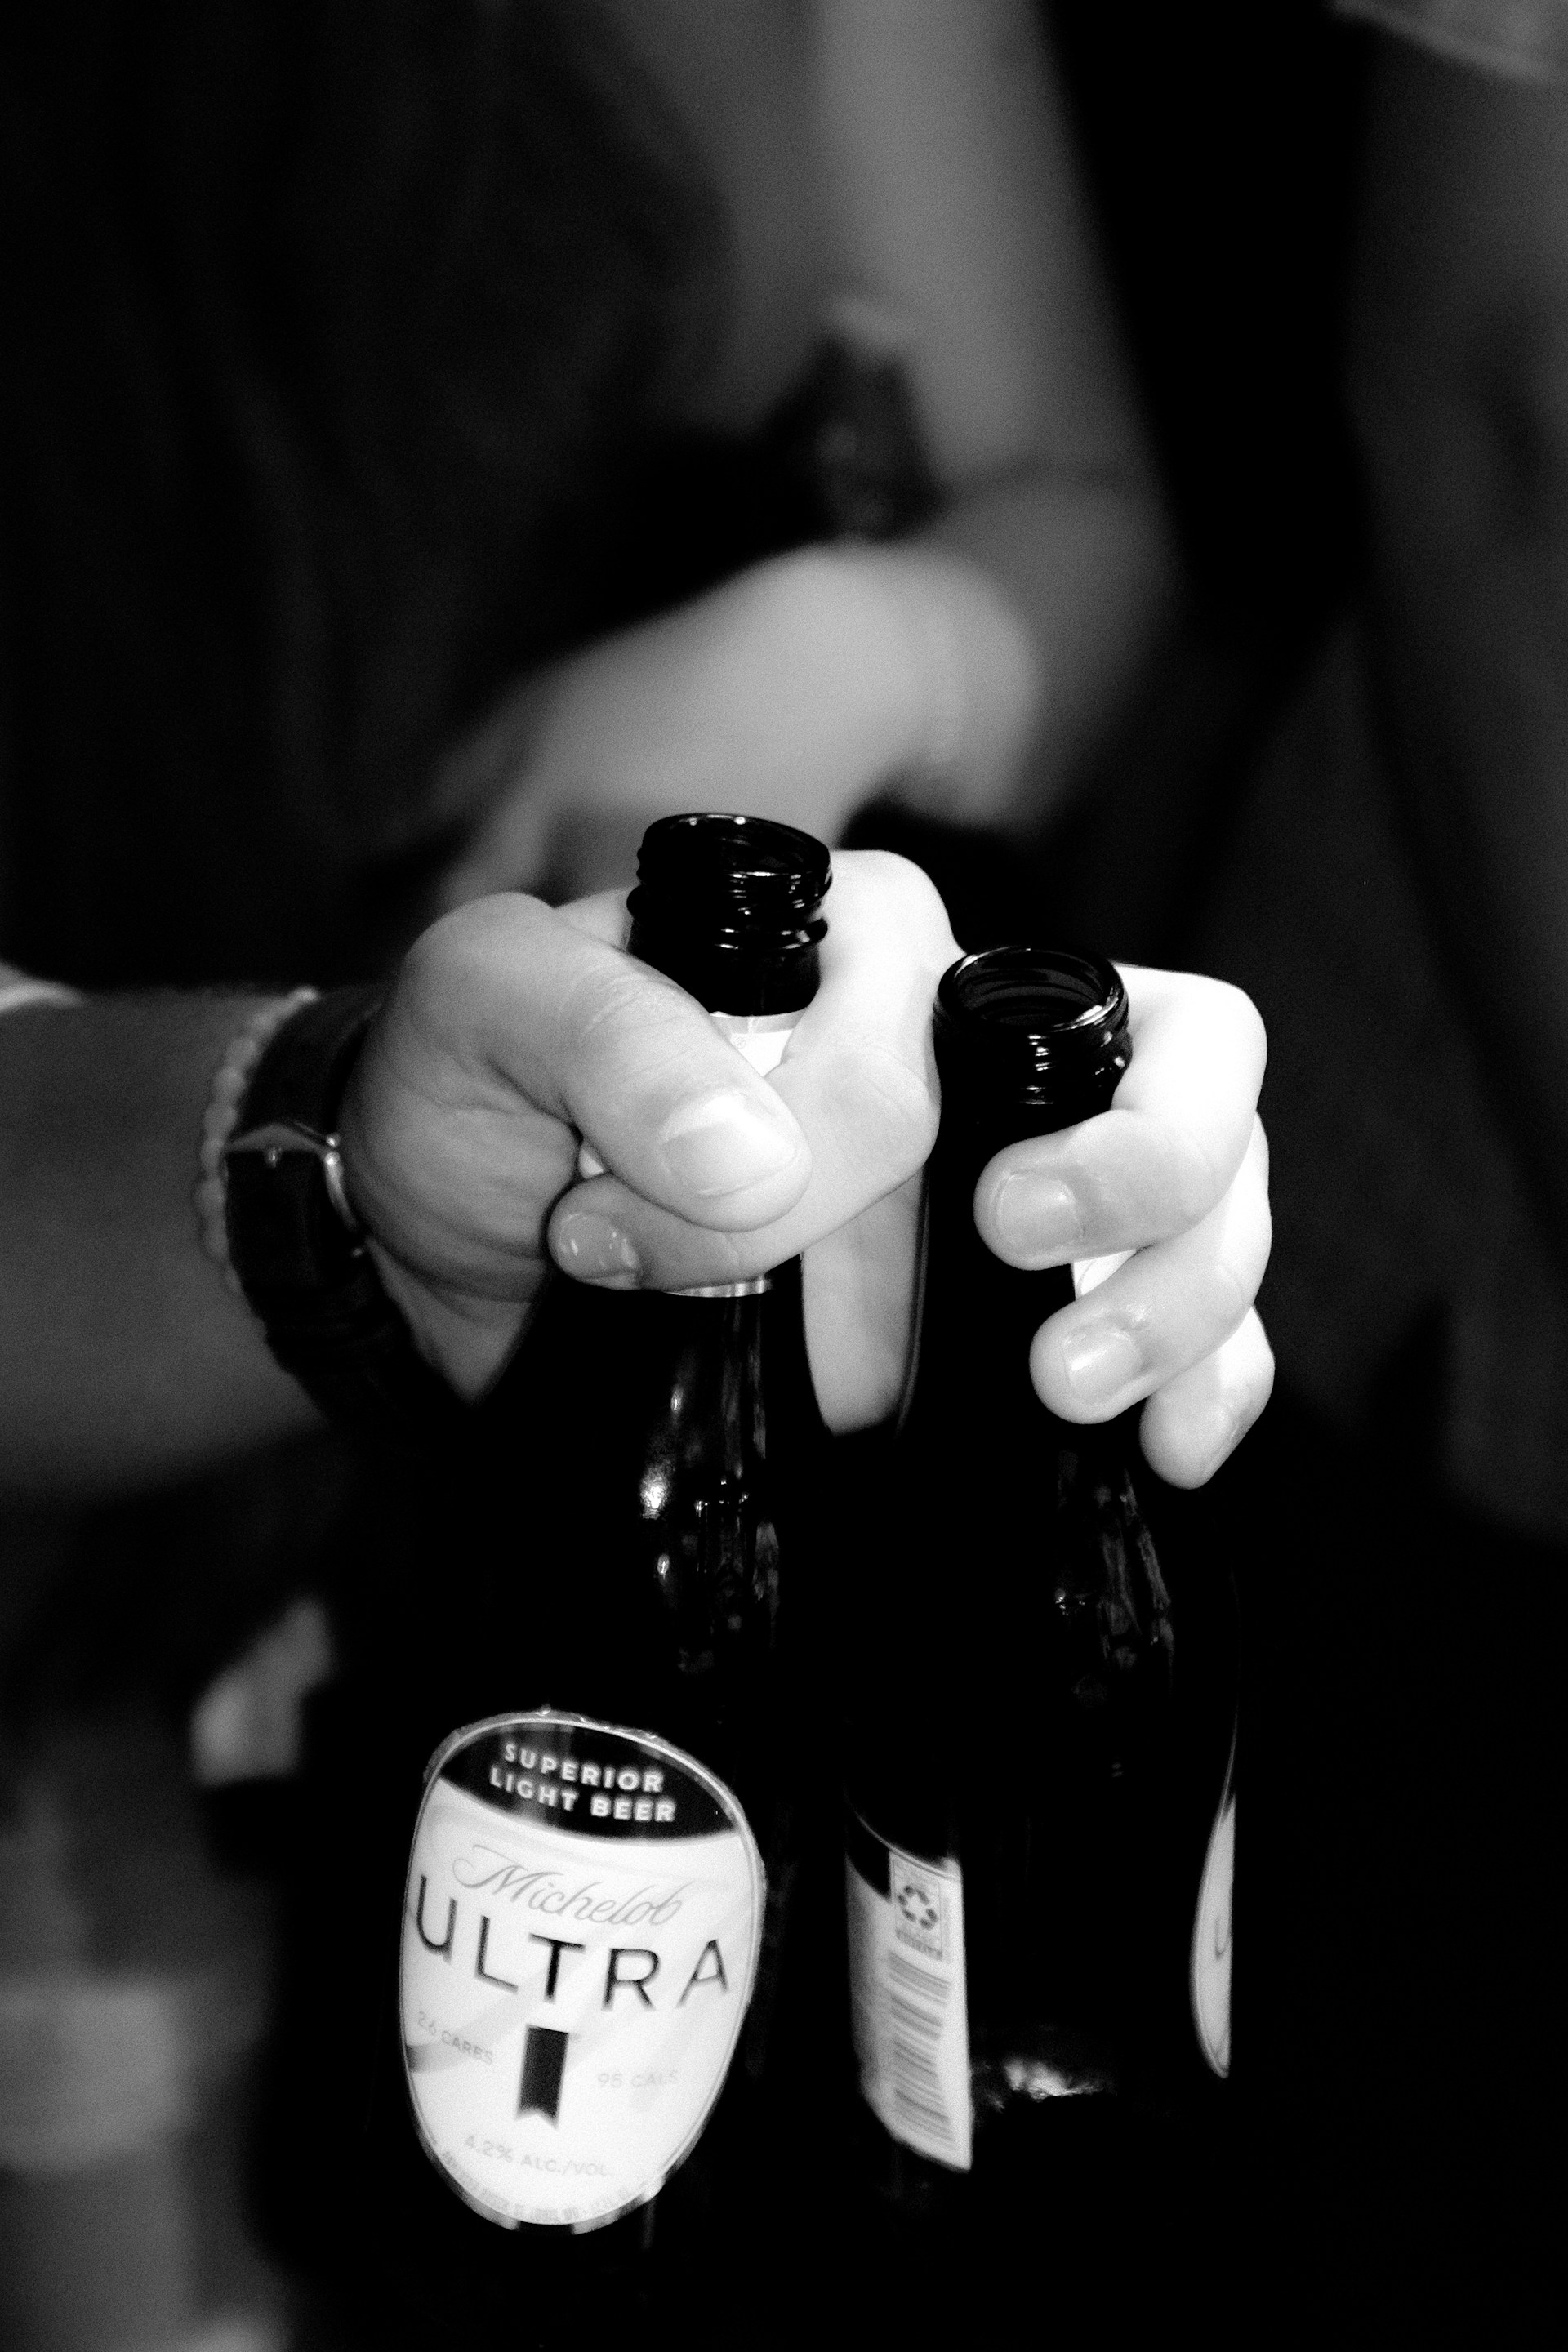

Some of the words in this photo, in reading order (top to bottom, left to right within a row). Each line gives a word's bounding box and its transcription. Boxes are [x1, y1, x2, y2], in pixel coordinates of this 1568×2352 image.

[505, 1743, 664, 1793] SUPERIOR
[490, 1767, 579, 1811] LIGHT
[590, 1796, 677, 1822] BEER
[452, 1844, 693, 1926] Michelob
[416, 1875, 729, 2011] ULTRA
[597, 2072, 622, 2088] 95
[630, 2069, 679, 2088] CALS
[465, 2135, 513, 2163] 4.2%
